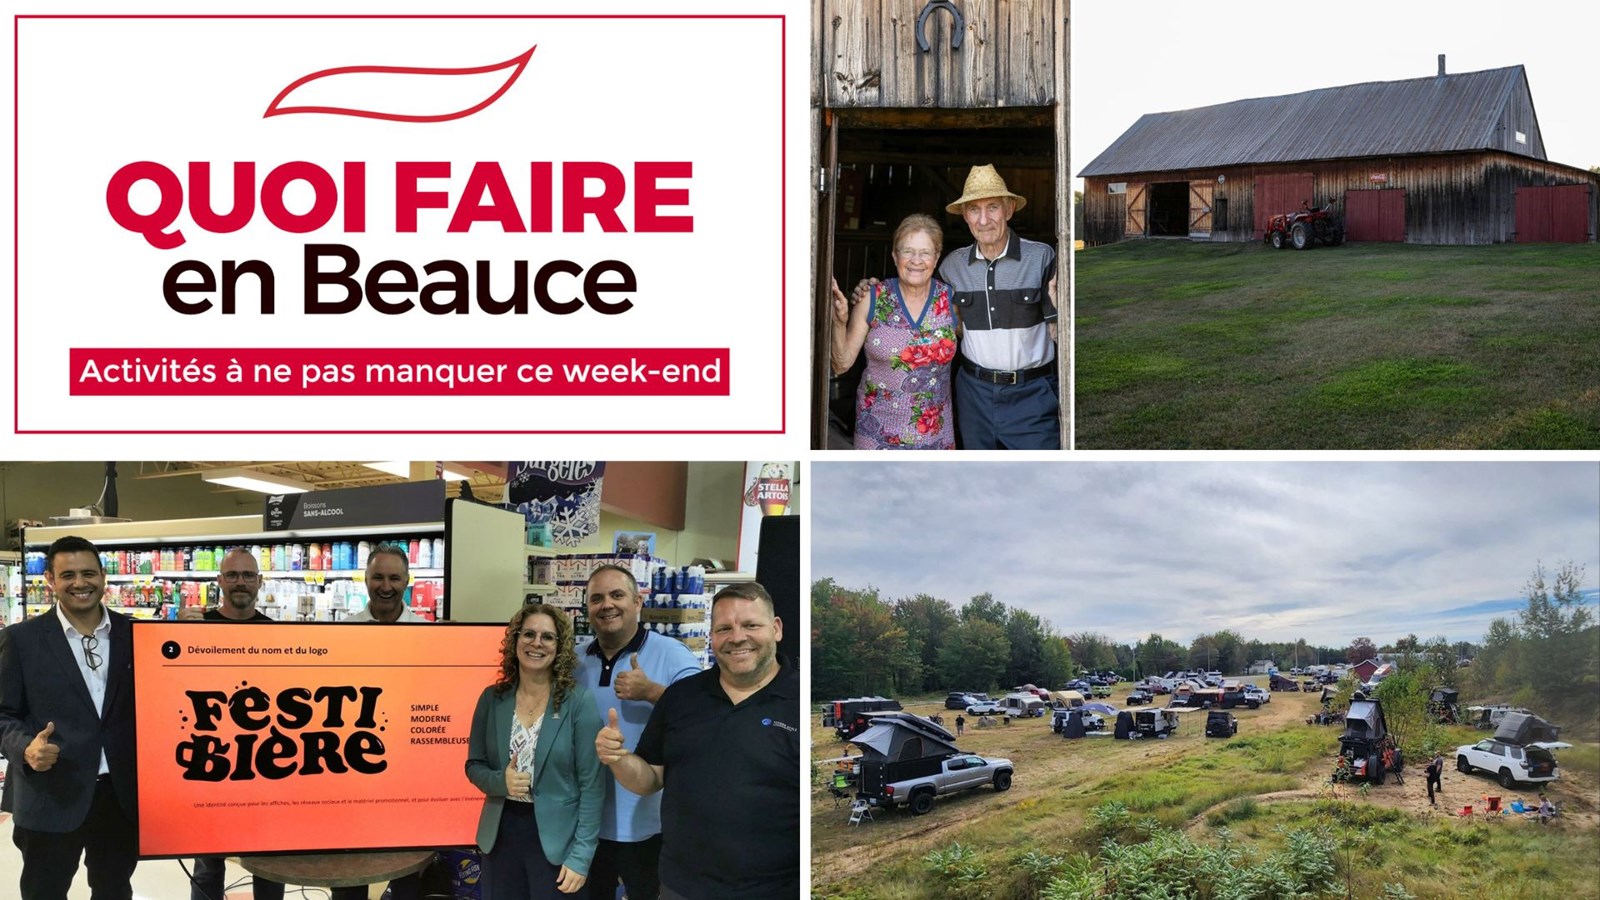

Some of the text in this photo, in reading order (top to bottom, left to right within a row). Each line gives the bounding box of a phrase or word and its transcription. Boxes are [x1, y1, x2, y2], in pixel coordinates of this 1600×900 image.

[758, 483, 788, 491] STELLA
[303, 508, 344, 517] SANS-ALCOOL
[187, 645, 246, 655] Dévoilement
[248, 645, 260, 655] du
[261, 647, 282, 655] nom
[284, 646, 293, 655] et
[295, 645, 307, 655] du
[308, 645, 329, 657] logo
[410, 704, 439, 712] SIMPLE
[410, 715, 451, 723] MODERNE
[410, 724, 446, 734] COLORÉE
[410, 737, 470, 745] RASSEMBLEUSE
